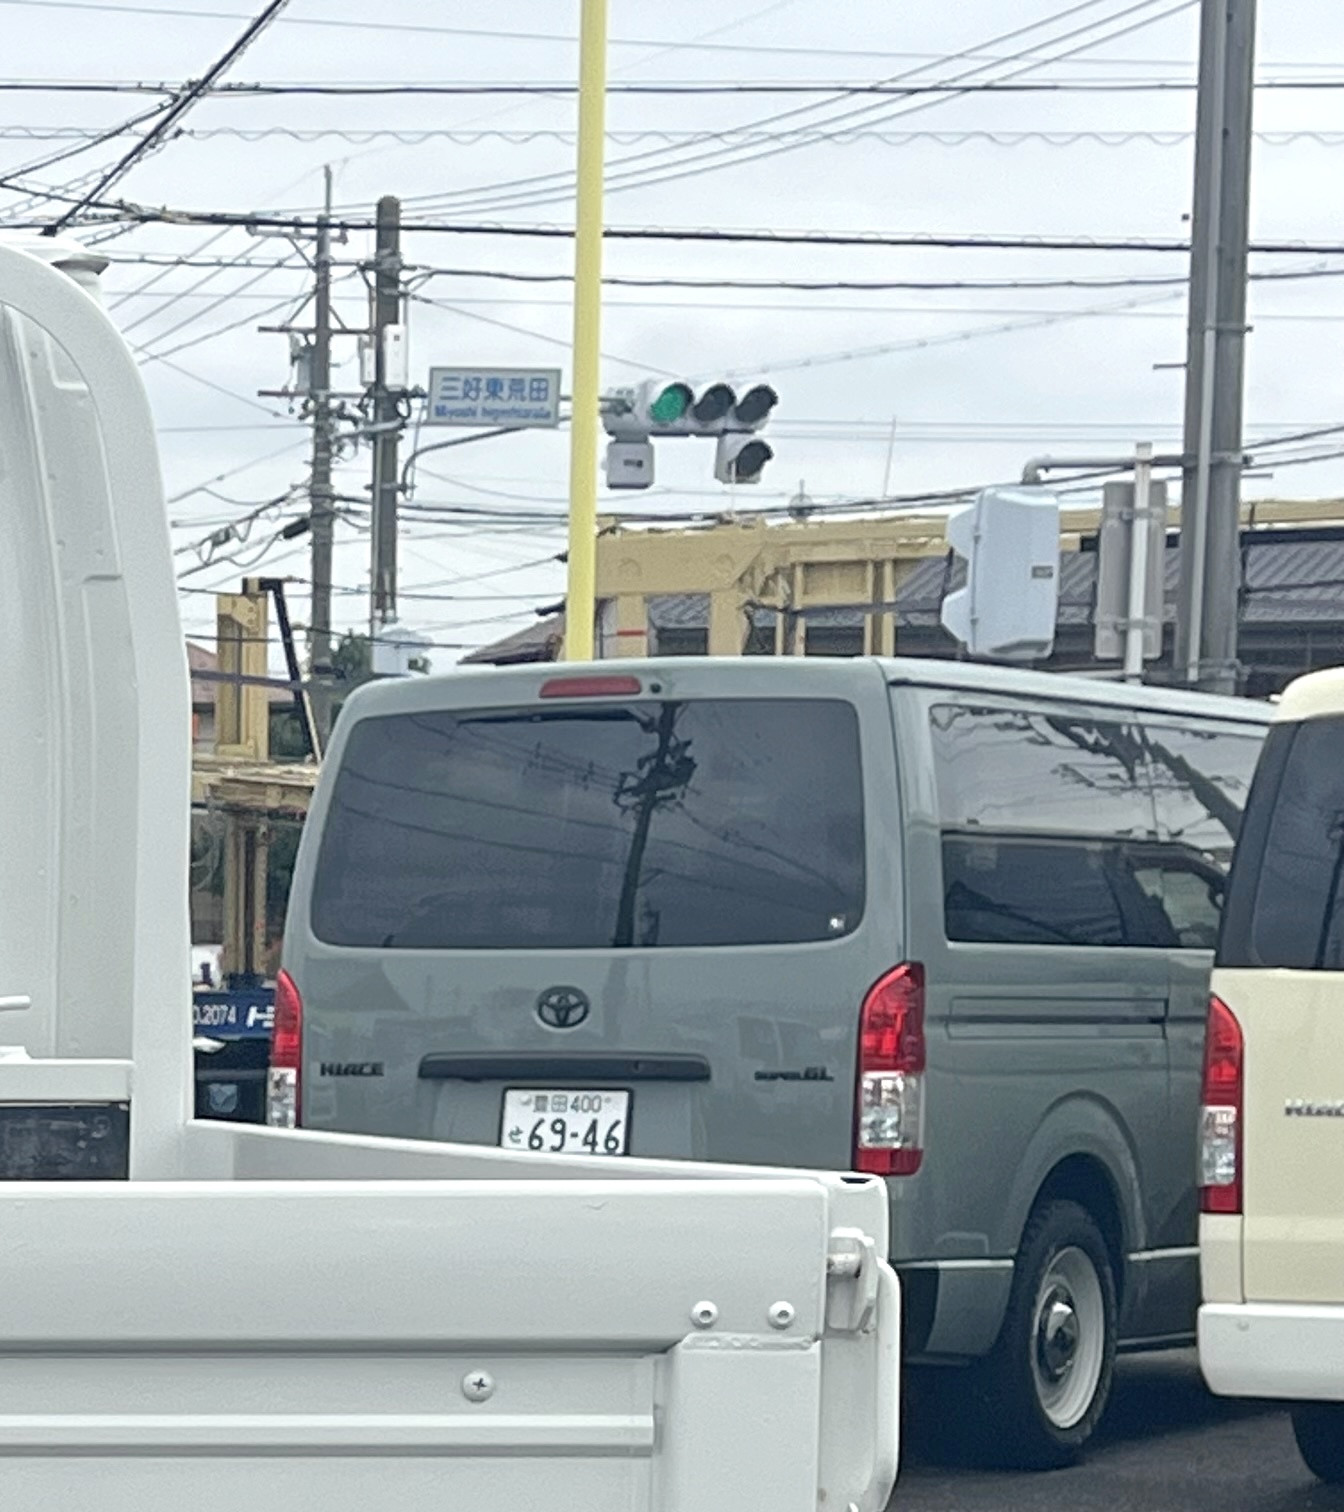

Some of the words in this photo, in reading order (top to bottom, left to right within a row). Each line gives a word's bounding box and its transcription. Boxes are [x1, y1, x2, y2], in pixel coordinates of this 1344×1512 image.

[439, 377, 548, 402] 三好東荒田
[570, 1095, 602, 1113] 400
[528, 1117, 622, 1154] 69-46
